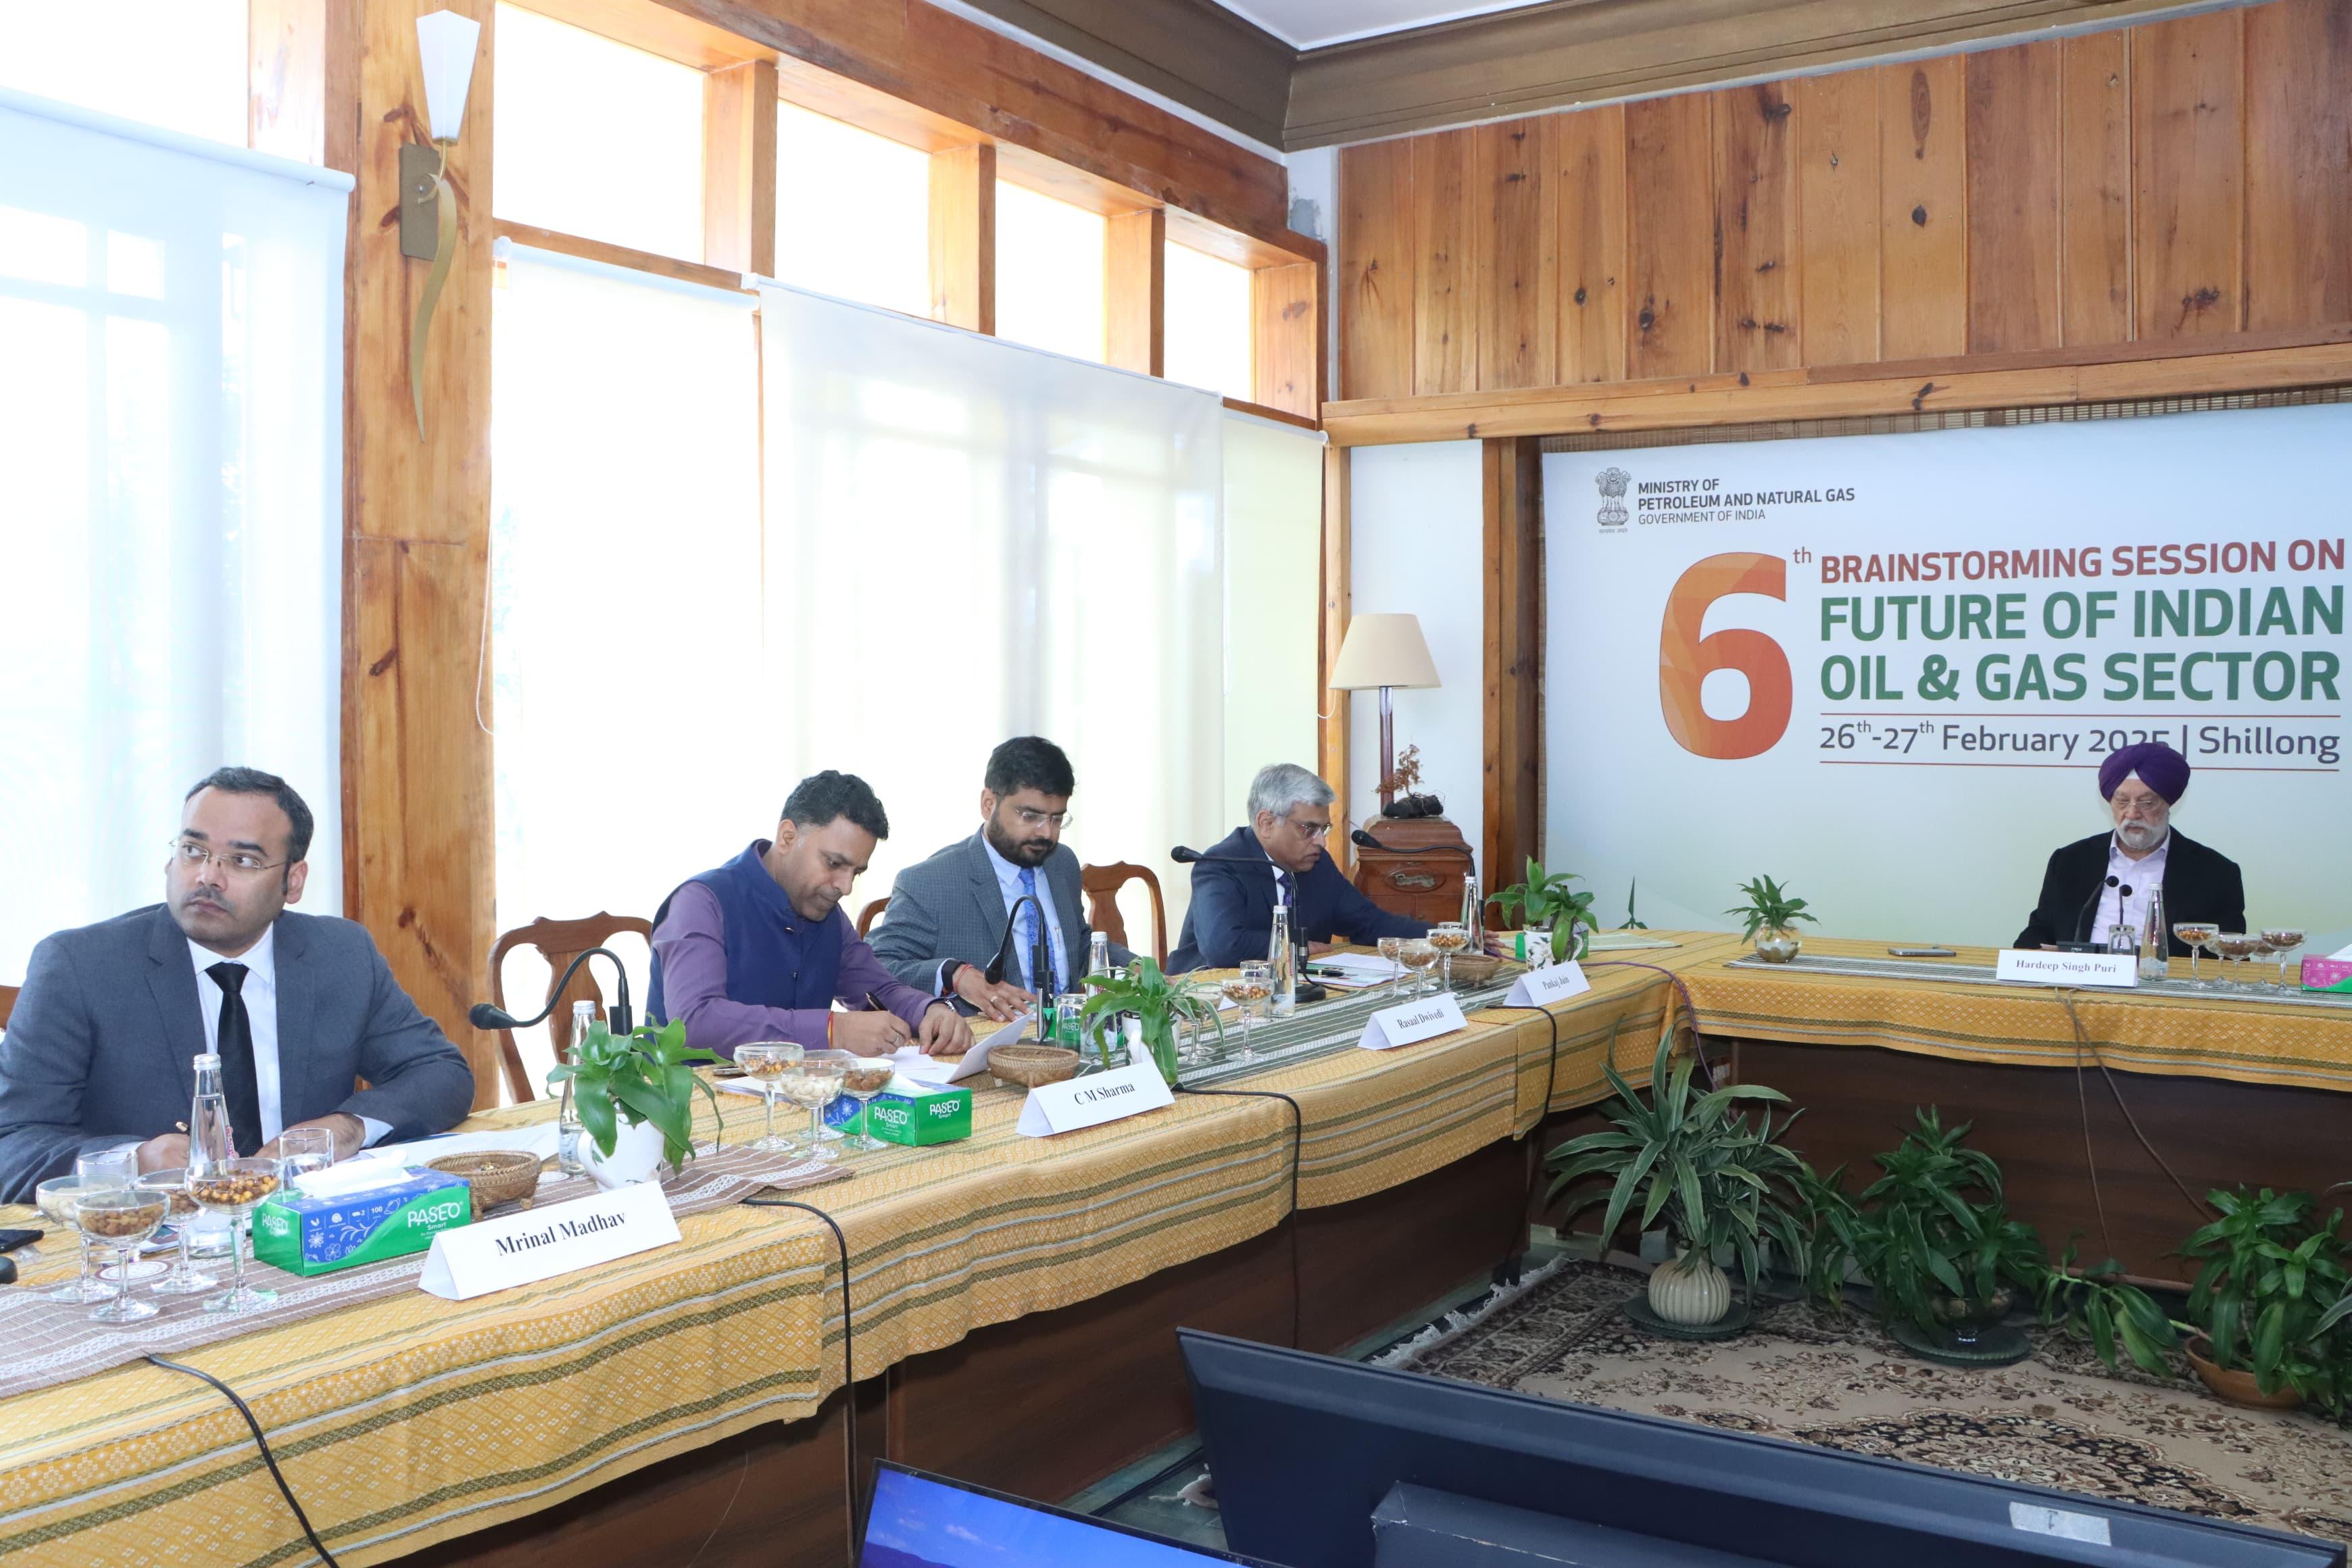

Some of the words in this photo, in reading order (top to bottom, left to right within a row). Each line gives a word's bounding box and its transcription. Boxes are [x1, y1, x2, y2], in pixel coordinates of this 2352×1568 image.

[1638, 479, 1698, 494] MINISTRY
[1702, 479, 1719, 491] OF
[1638, 495, 1720, 510] PETROLEUM
[1724, 493, 1753, 506] AND
[1757, 489, 1822, 506] NATURAL
[1826, 488, 1855, 502] GAS
[1638, 511, 1715, 524] GOVERNMENT
[1717, 510, 1732, 521] OF
[1735, 509, 1766, 520] INDIA
[1821, 546, 2102, 583] BRAINSTORMING
[2111, 541, 2276, 576] SESSION
[2287, 538, 2345, 571] ON
[1821, 593, 2026, 641] FUTURE
[2042, 591, 2117, 639] OF
[2134, 585, 2344, 638] INDIAN
[1821, 654, 1903, 700] OIL
[1917, 654, 1960, 701] &
[1976, 653, 2087, 701] GAS
[2103, 650, 2341, 702] SECTOR
[1943, 725, 2080, 760] February
[2199, 726, 2341, 764] Shillong
[2016, 959, 2059, 972] Hardeep
[2061, 962, 2090, 973] Singh
[2094, 963, 2117, 973] Puri
[1419, 1008, 1444, 1023] Dwivedi
[1074, 1092, 1085, 1105] C
[1083, 1089, 1097, 1103] M
[1096, 1083, 1135, 1100] Sharma
[874, 1106, 908, 1125] PASEO
[929, 1100, 960, 1116] PASEO
[371, 1205, 383, 1214] 100
[407, 1202, 461, 1228] PASEO
[427, 1222, 447, 1231] Smart
[495, 1226, 557, 1256] Mrinal
[558, 1212, 625, 1240] Madhav
